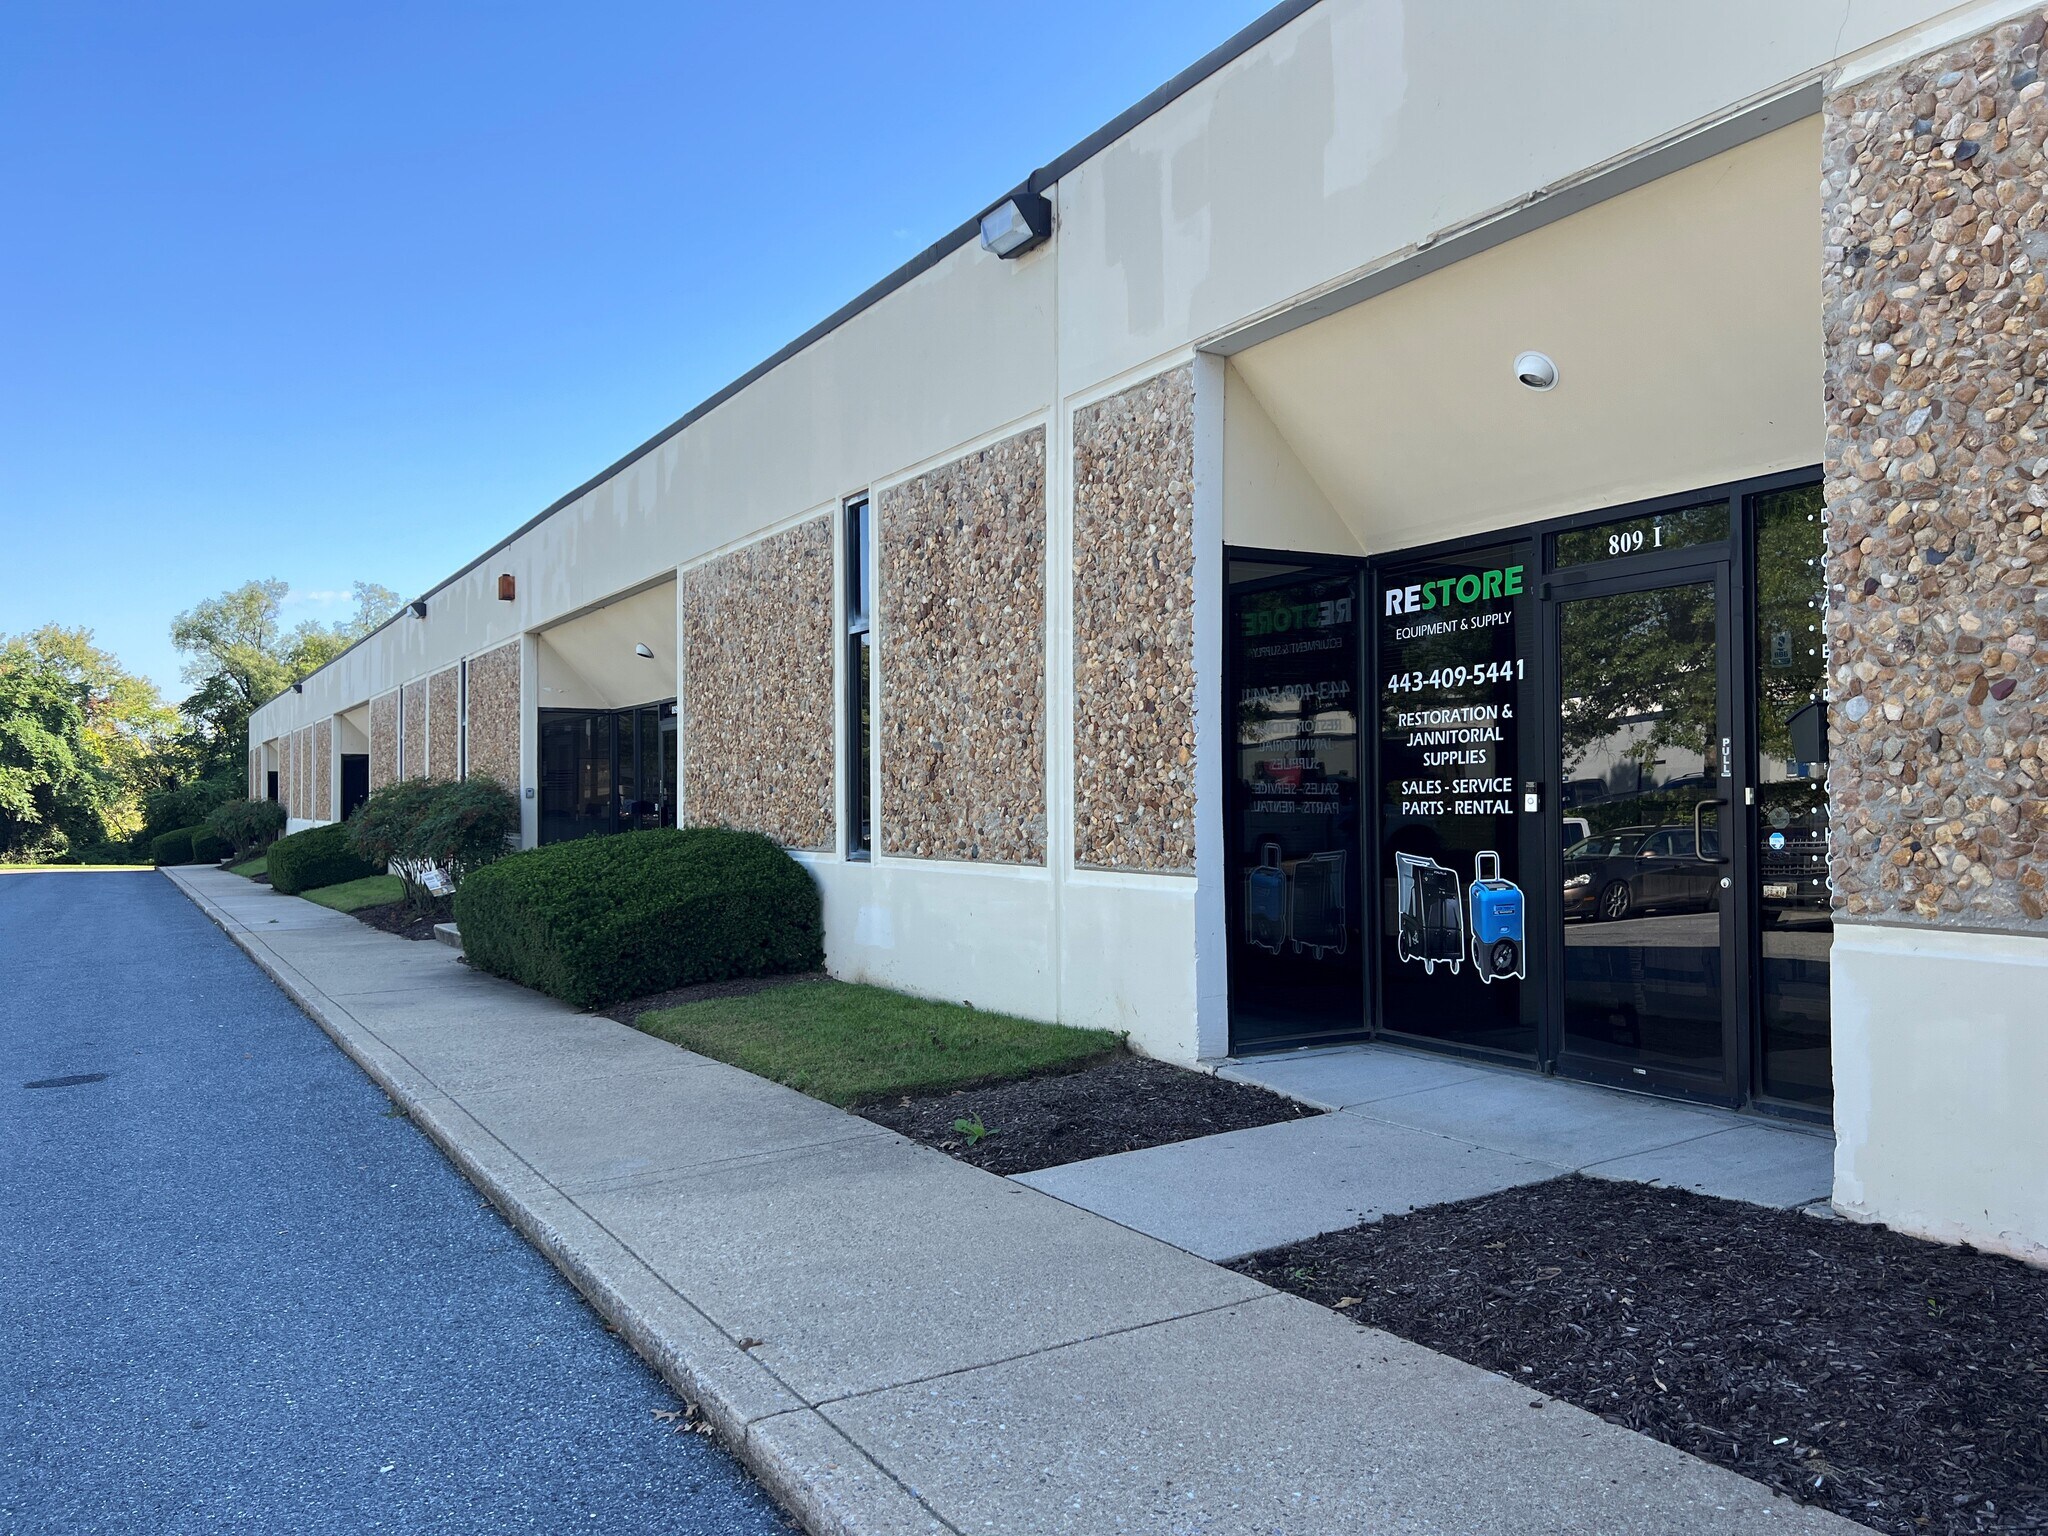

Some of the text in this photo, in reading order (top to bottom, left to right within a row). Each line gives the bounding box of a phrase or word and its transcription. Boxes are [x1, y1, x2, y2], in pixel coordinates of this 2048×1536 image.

[1608, 530, 1643, 555] 809
[1385, 565, 1524, 617] RESTORE
[1396, 612, 1512, 640] EQUIPMENT & SUPPLY
[1388, 659, 1524, 694] 443-409-5441
[1398, 704, 1513, 727] RESTORATION &
[1407, 727, 1504, 747] JANNITORIAL
[1423, 749, 1487, 767] SUPPLIES
[1722, 738, 1730, 773] PULL
[1402, 780, 1442, 795] SALES
[1452, 778, 1513, 793] SERVICE
[1402, 800, 1444, 815] PARTS
[1455, 799, 1513, 815] RENTAL
